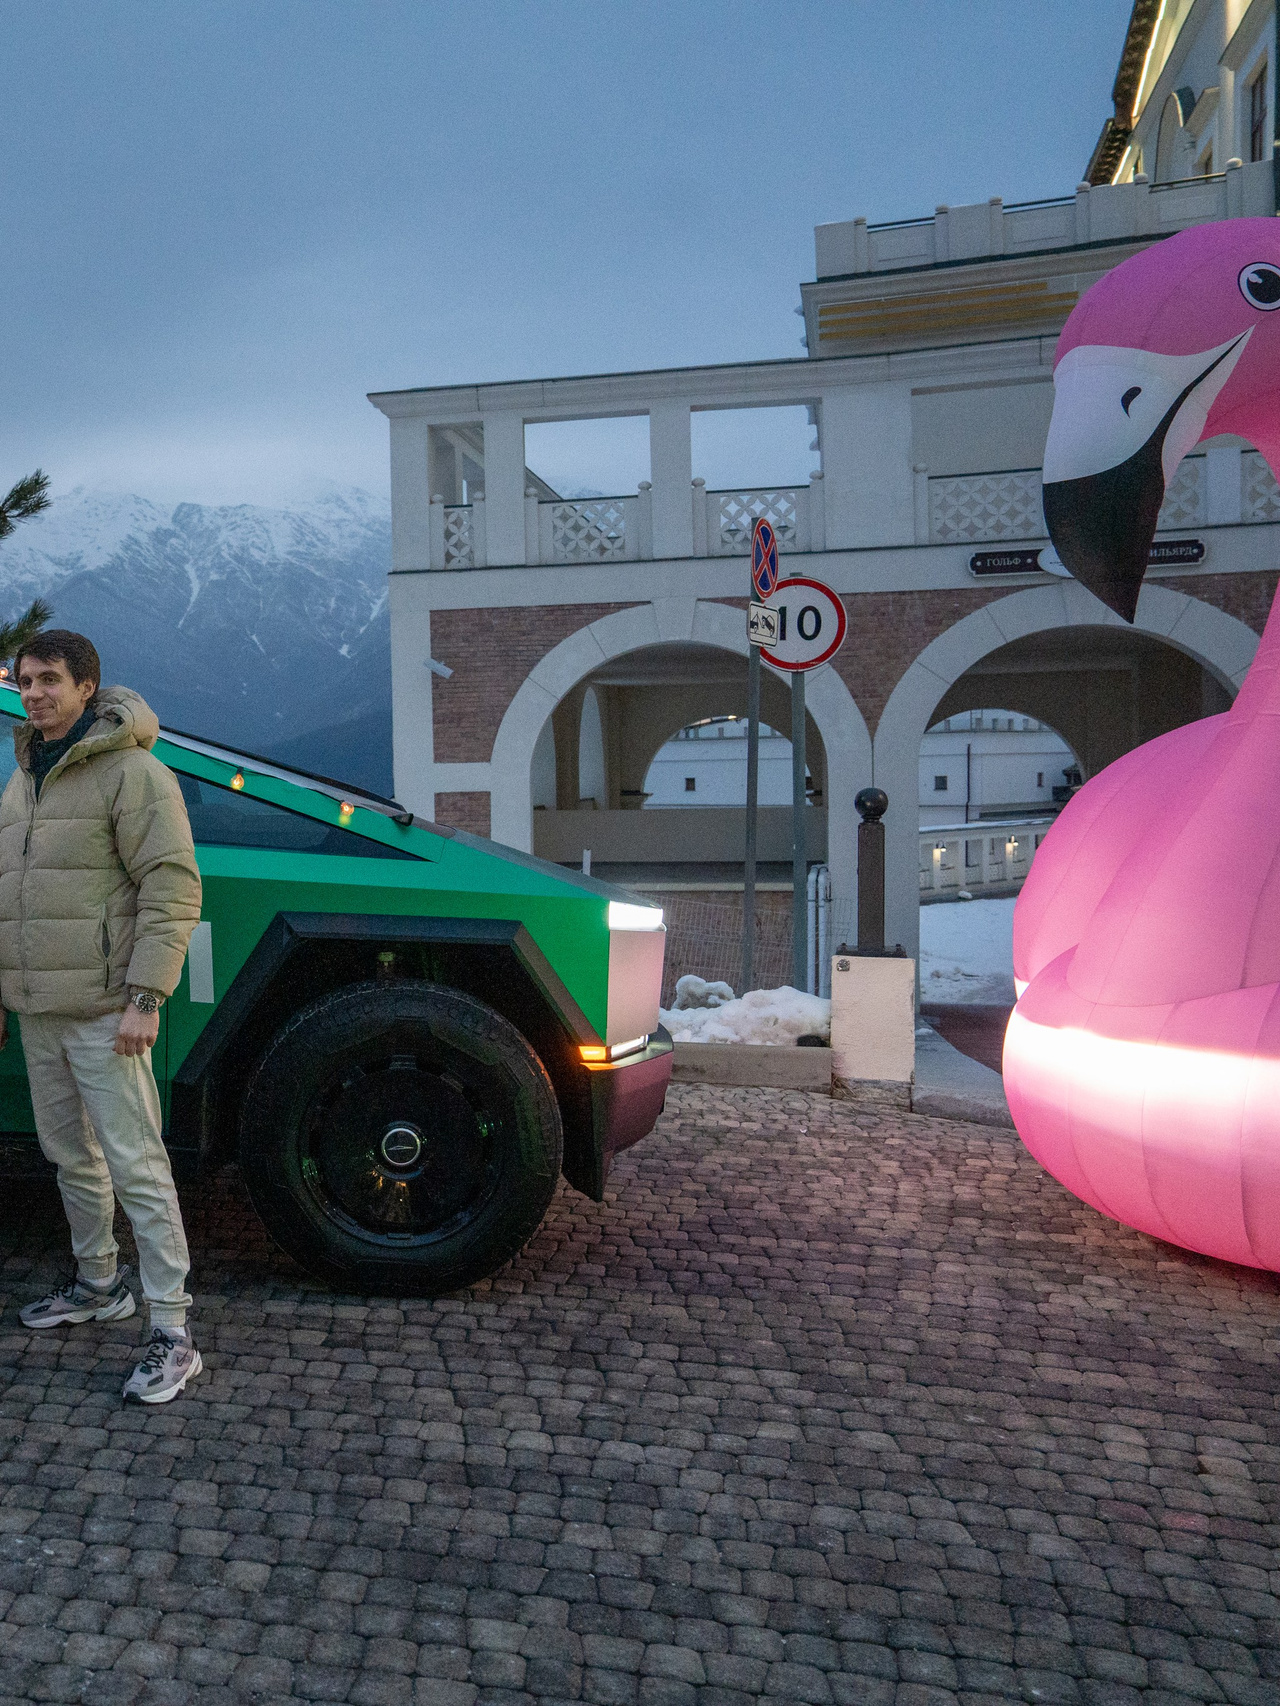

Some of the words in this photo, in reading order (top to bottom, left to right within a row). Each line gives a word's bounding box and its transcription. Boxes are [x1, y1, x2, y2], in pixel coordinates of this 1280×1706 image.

[986, 557, 1021, 567] ГОЛЬФ
[1149, 546, 1193, 558] ИЛЬЯРД
[778, 605, 822, 641] 10
